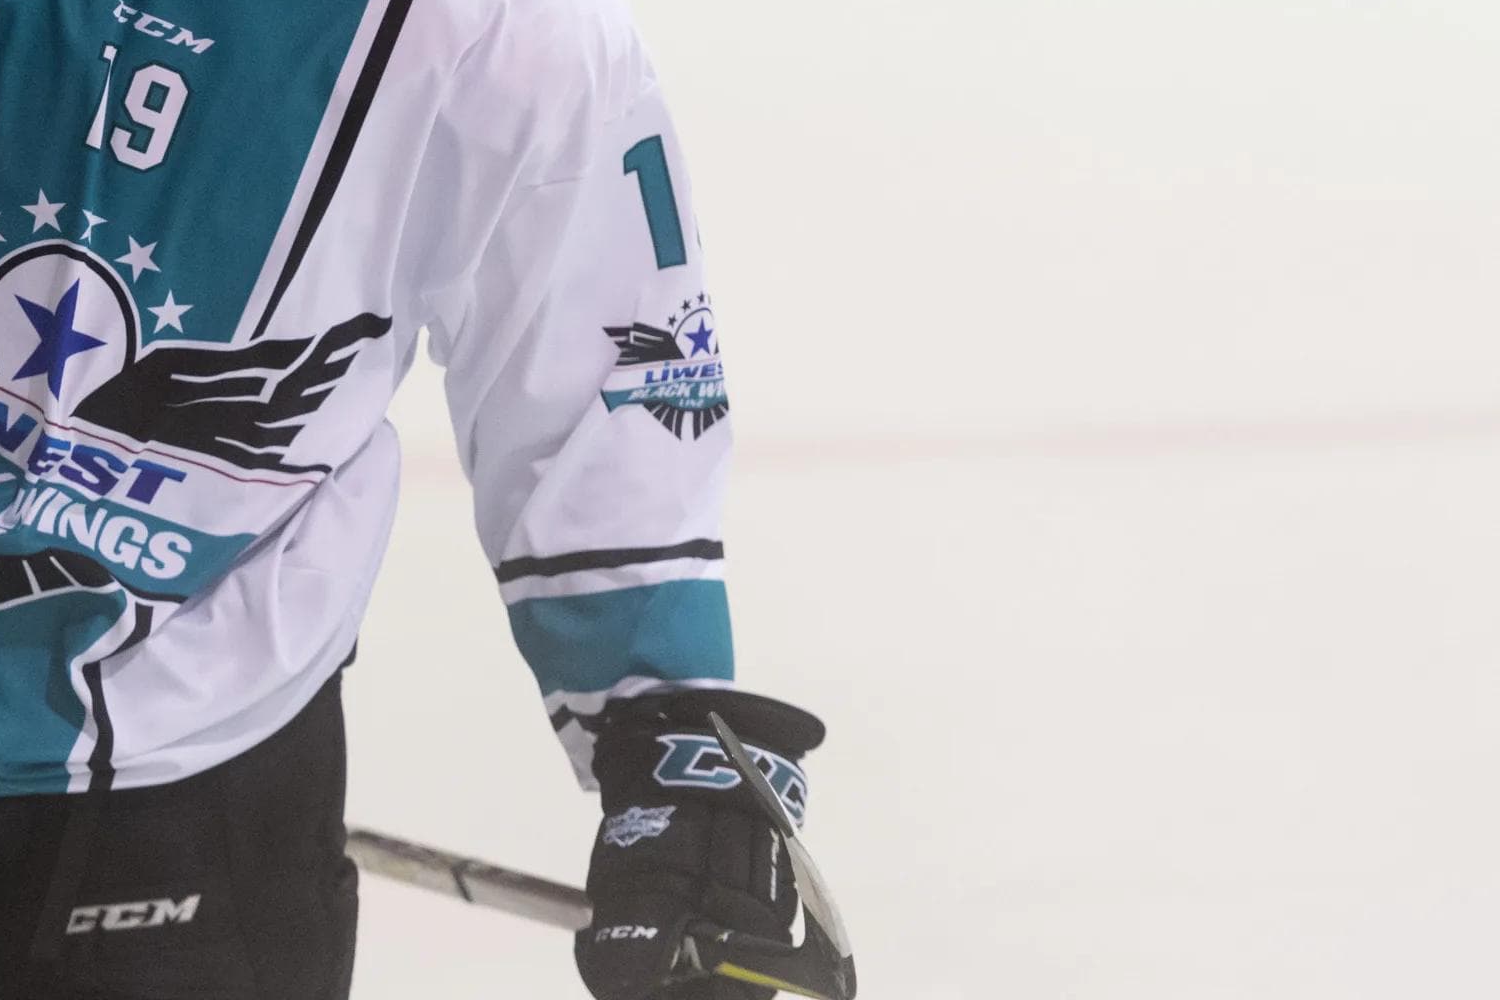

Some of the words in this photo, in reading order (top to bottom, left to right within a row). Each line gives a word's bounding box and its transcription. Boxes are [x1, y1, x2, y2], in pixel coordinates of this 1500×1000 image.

[115, 0, 215, 54] CCM
[623, 134, 688, 270] 1
[66, 894, 201, 935] CCM
